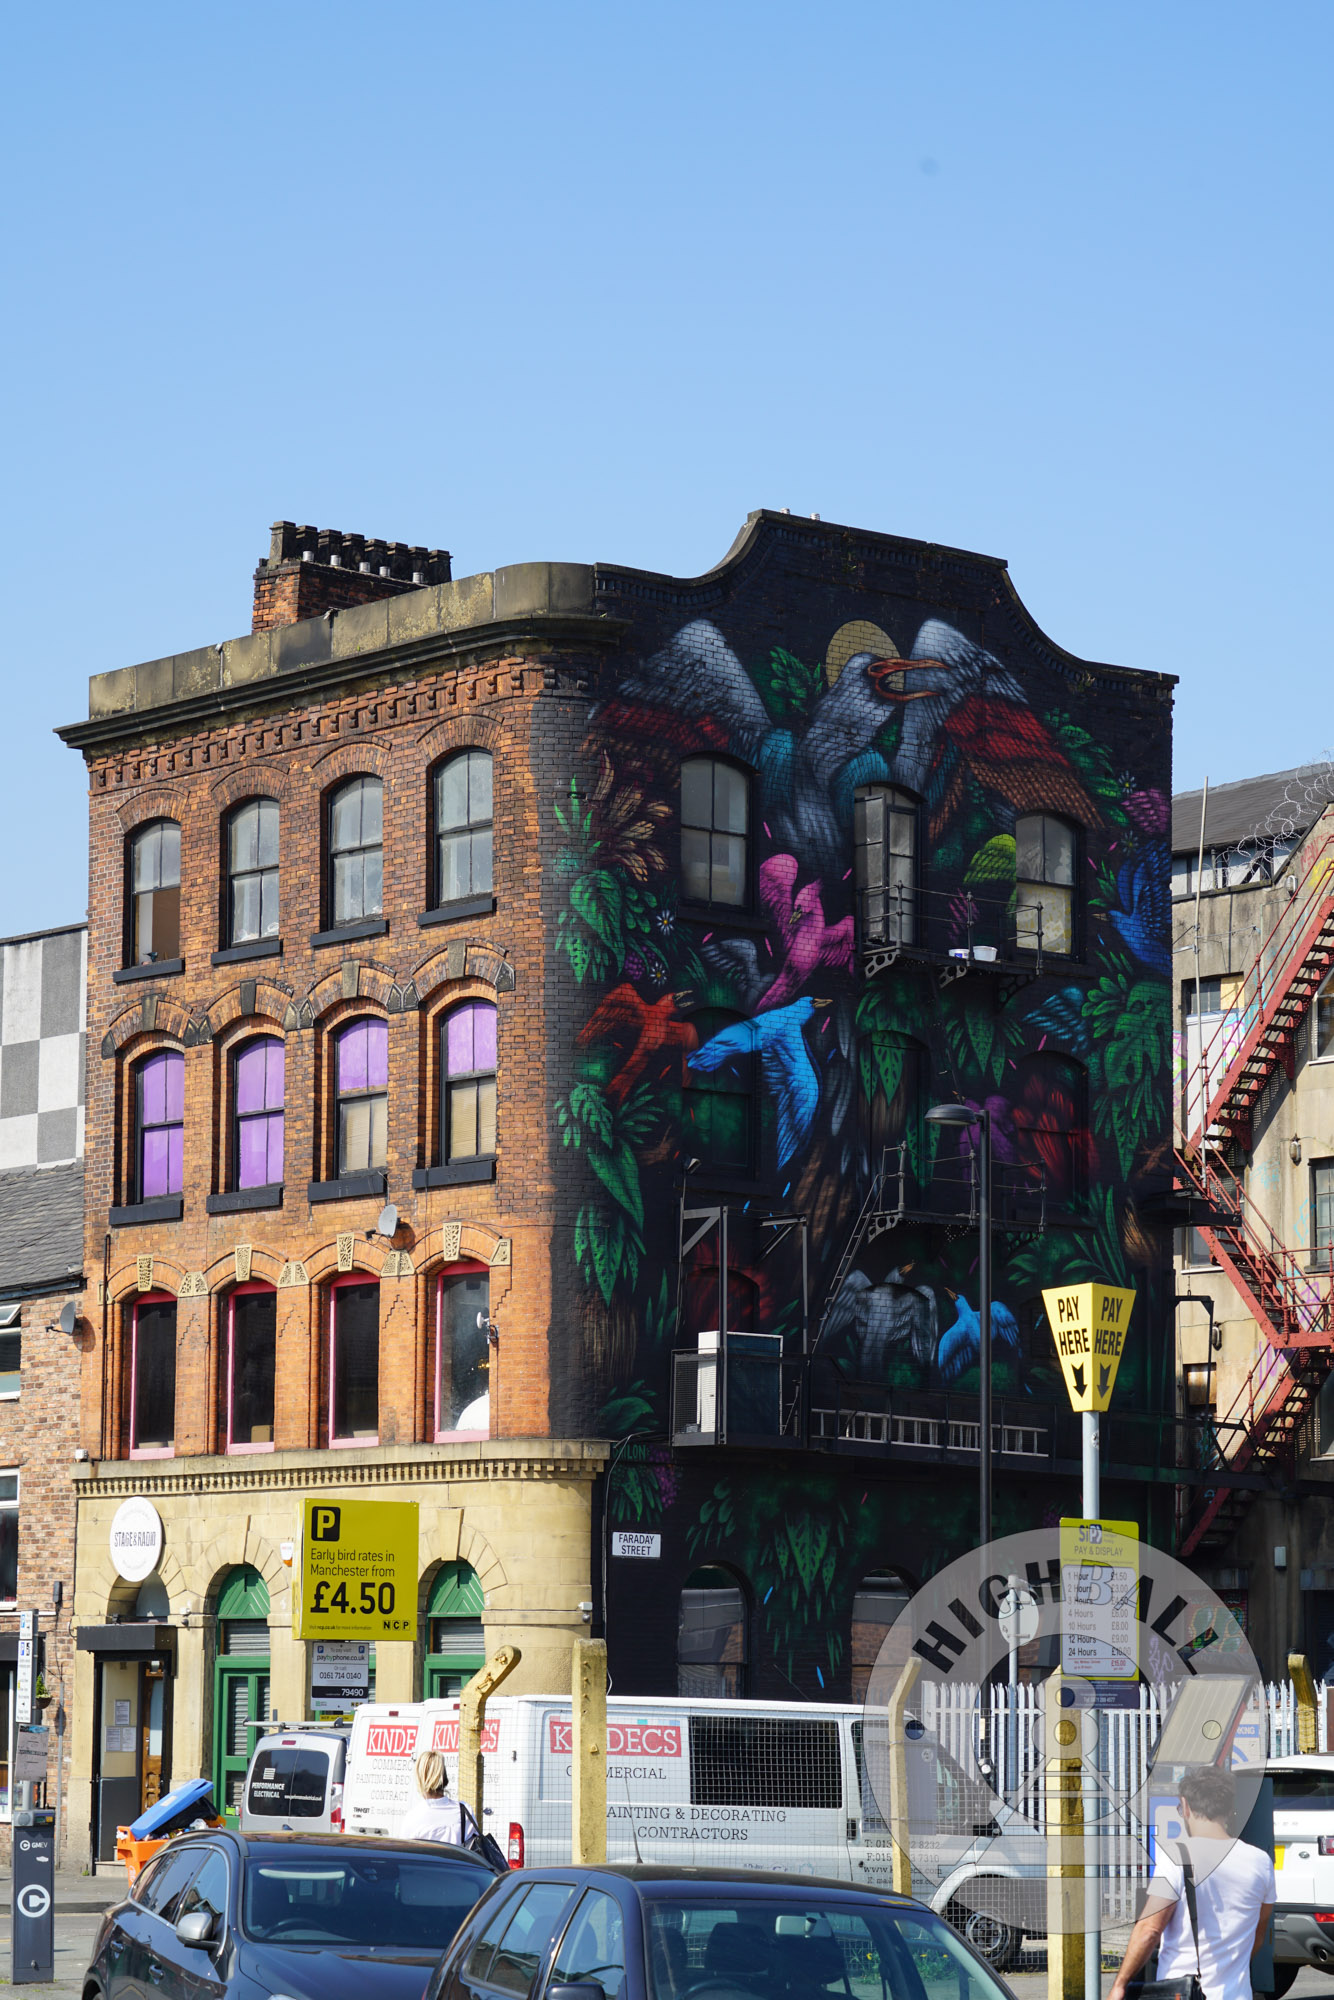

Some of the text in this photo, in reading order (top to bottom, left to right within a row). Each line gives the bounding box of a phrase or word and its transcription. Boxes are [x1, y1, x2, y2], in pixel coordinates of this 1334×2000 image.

[1058, 1296, 1080, 1323] PAY
[1101, 1296, 1123, 1323] PAY
[1058, 1328, 1090, 1356] HERE
[1094, 1329, 1122, 1356] HERE
[317, 1510, 336, 1538] P
[618, 1534, 654, 1544] FARADAY
[310, 1548, 395, 1564] Early bird rates in
[621, 1545, 651, 1556] STREET
[1074, 1546, 1124, 1556] PAY & DISPLAY
[310, 1564, 395, 1577] Manchester from
[1074, 1572, 1089, 1580] Hour
[1068, 1584, 1072, 1592] 2
[1111, 1584, 1128, 1593] £3.00
[310, 1580, 395, 1615] £4.50
[1067, 1596, 1072, 1605] 3
[1074, 1596, 1094, 1605] Hours
[1074, 1609, 1094, 1618] Hours
[1068, 1622, 1128, 1631] 10 Hours £8.00
[1068, 1634, 1128, 1643] 12 Hours £9.00
[1068, 1647, 1131, 1656] 24 Hours £10.00
[368, 1728, 416, 1753] KINDE
[432, 1722, 498, 1750] KINCS
[553, 1726, 677, 1754] KDECS
[372, 1759, 412, 1771] COMMERC
[566, 1766, 667, 1779] CMERCIAL
[356, 1774, 386, 1784] PAINTING
[252, 1782, 285, 1790] PERFORMANCE
[371, 1790, 409, 1802] CONTRACT
[606, 1806, 787, 1822] AINTING & DECORATING
[637, 1826, 748, 1840] CONTRACTORS
[866, 1853, 892, 1861] F:015
